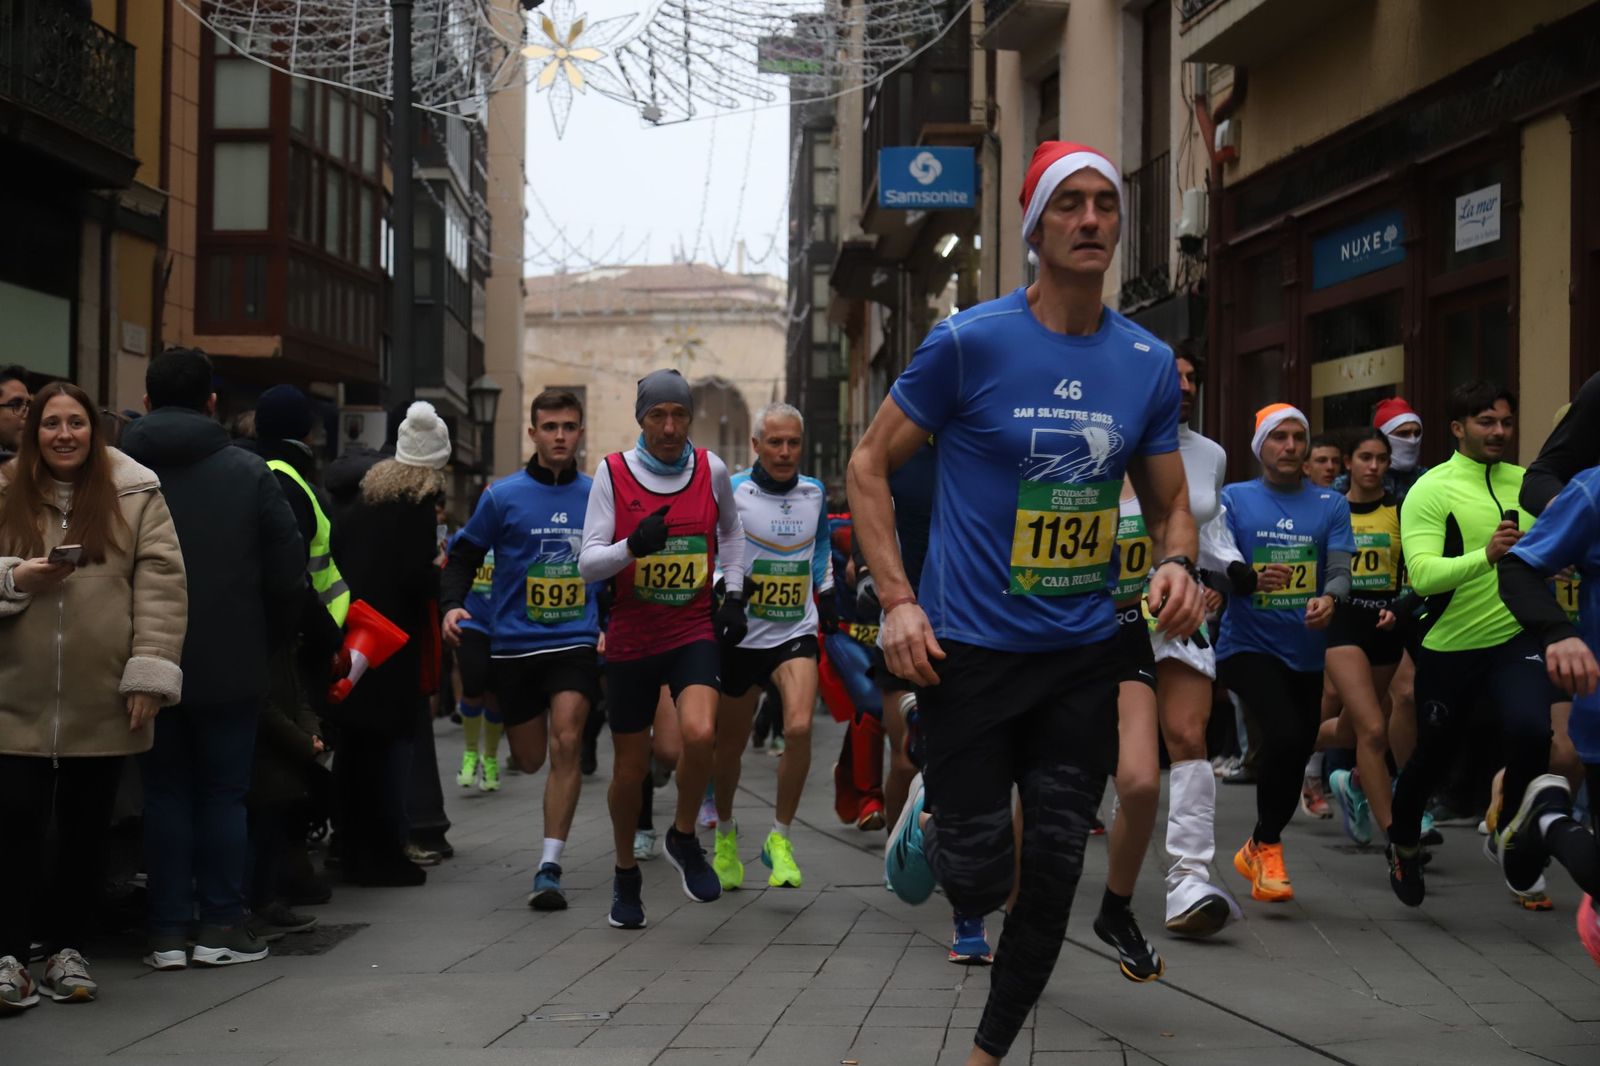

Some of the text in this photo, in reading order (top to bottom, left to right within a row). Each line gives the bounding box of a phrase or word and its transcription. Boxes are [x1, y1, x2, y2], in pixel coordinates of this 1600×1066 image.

[885, 189, 968, 204] Samsonite
[1341, 230, 1381, 261] NUXE
[1053, 378, 1083, 401] 46
[1013, 407, 1114, 425] SAN SILVESTRE 2025
[550, 512, 568, 524] 46
[1276, 518, 1294, 530] 46
[1028, 515, 1100, 560] 1134
[641, 562, 696, 589] 1324
[1041, 571, 1102, 588] CAJA RURAL
[531, 583, 578, 607] 693
[754, 581, 802, 606] 1255
